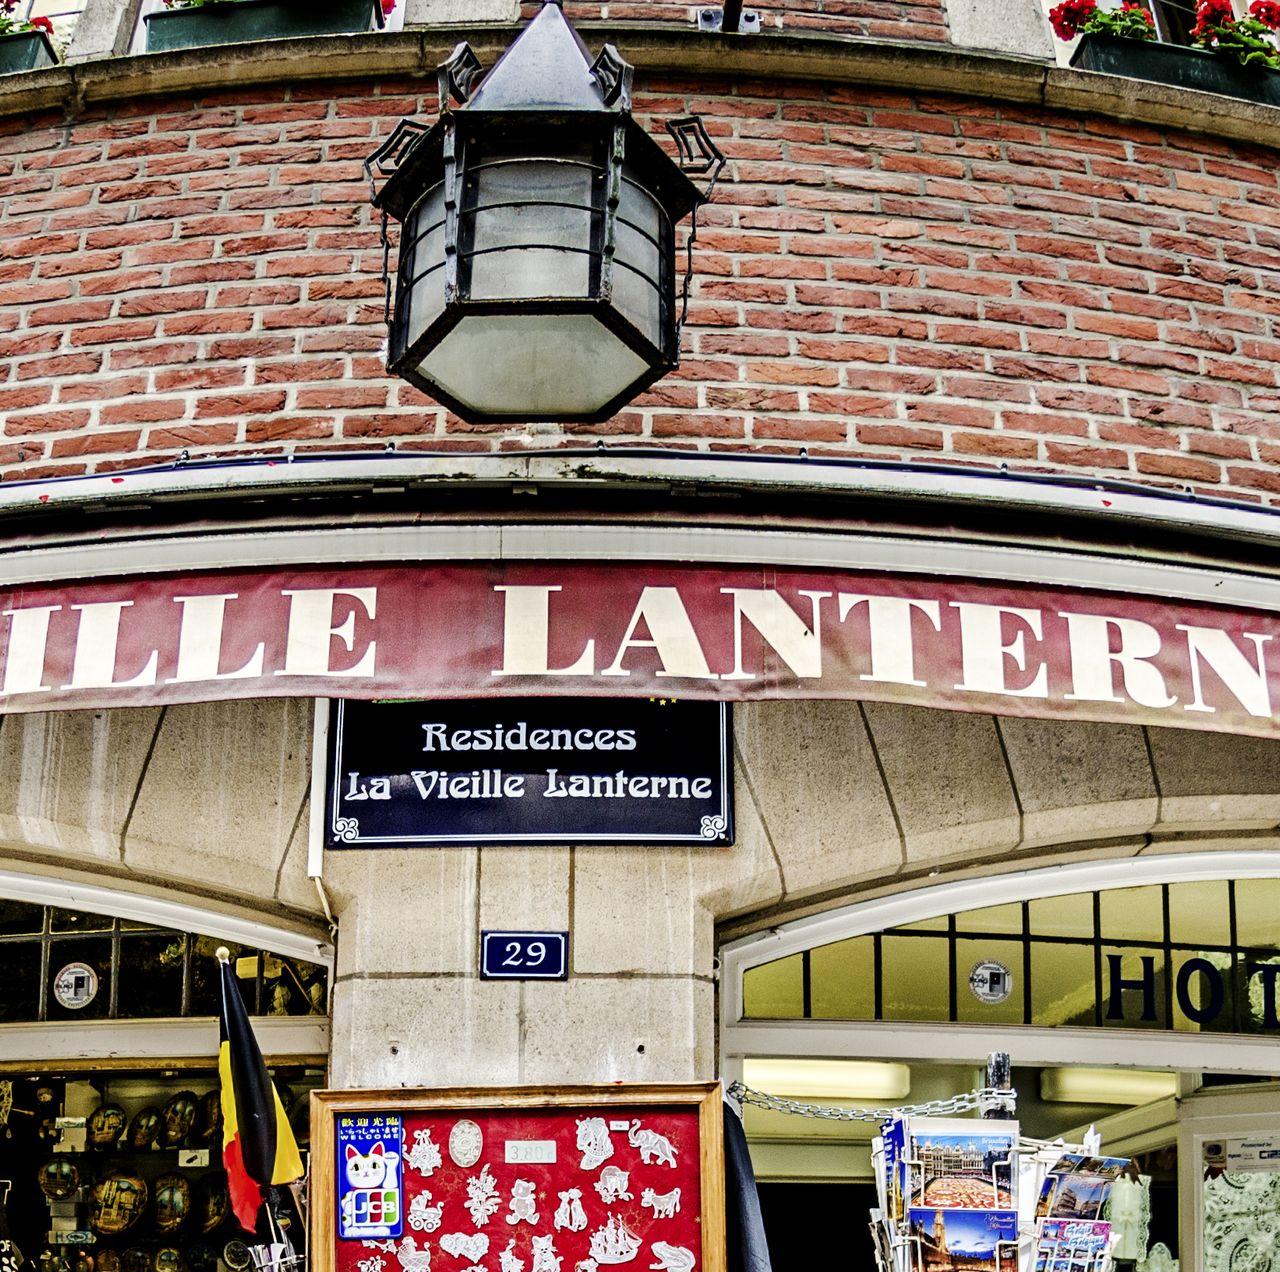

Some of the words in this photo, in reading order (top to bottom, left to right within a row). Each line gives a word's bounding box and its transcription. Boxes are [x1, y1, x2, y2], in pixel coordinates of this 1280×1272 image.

[421, 721, 637, 752] Residences
[344, 772, 392, 801] La
[411, 769, 525, 800] Vieille
[543, 769, 713, 799] Lanterne
[501, 942, 546, 968] 29
[355, 1201, 397, 1214] JCB
